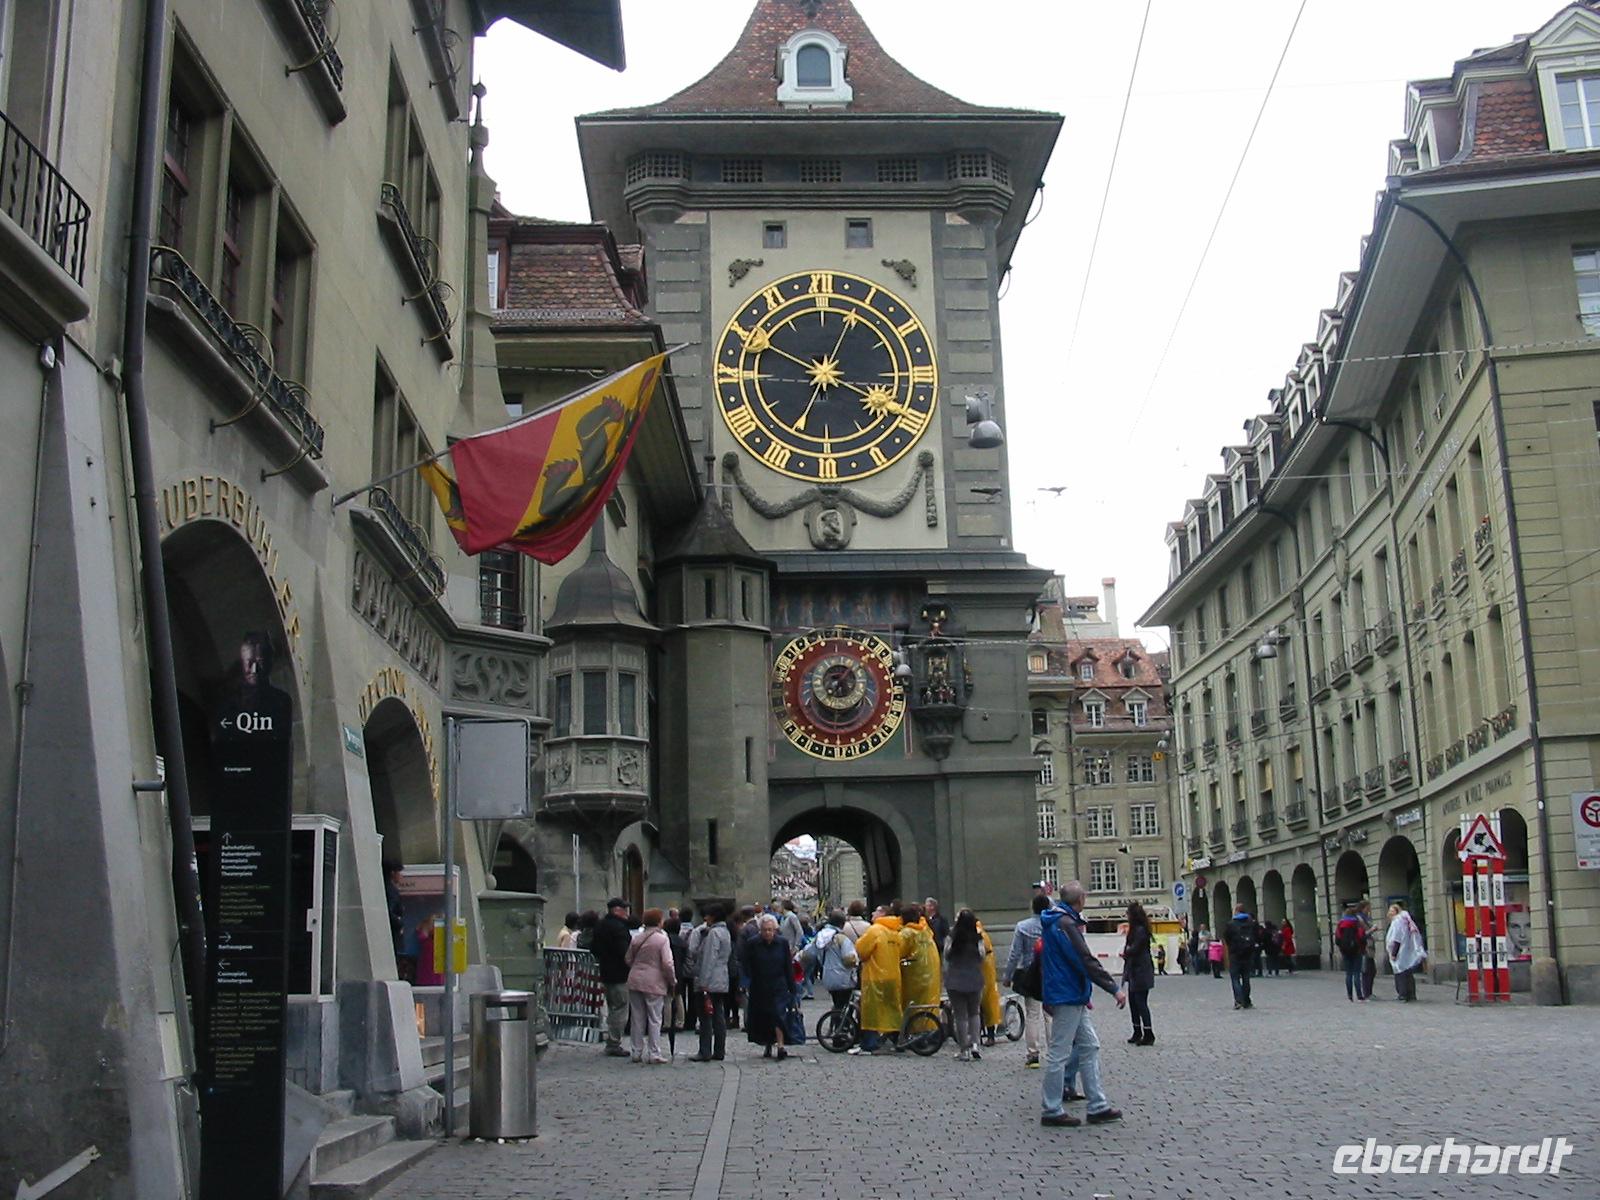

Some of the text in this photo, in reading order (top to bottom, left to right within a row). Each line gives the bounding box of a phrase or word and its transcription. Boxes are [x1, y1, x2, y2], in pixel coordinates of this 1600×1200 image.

[808, 274, 834, 294] XII
[762, 286, 786, 311] XI
[864, 286, 877, 305] I
[730, 320, 750, 340] X
[897, 318, 919, 338] II
[912, 364, 934, 383] III
[727, 404, 758, 438] VIII
[763, 440, 792, 470] VII
[818, 458, 838, 479] VI
[236, 711, 273, 734] Qin
